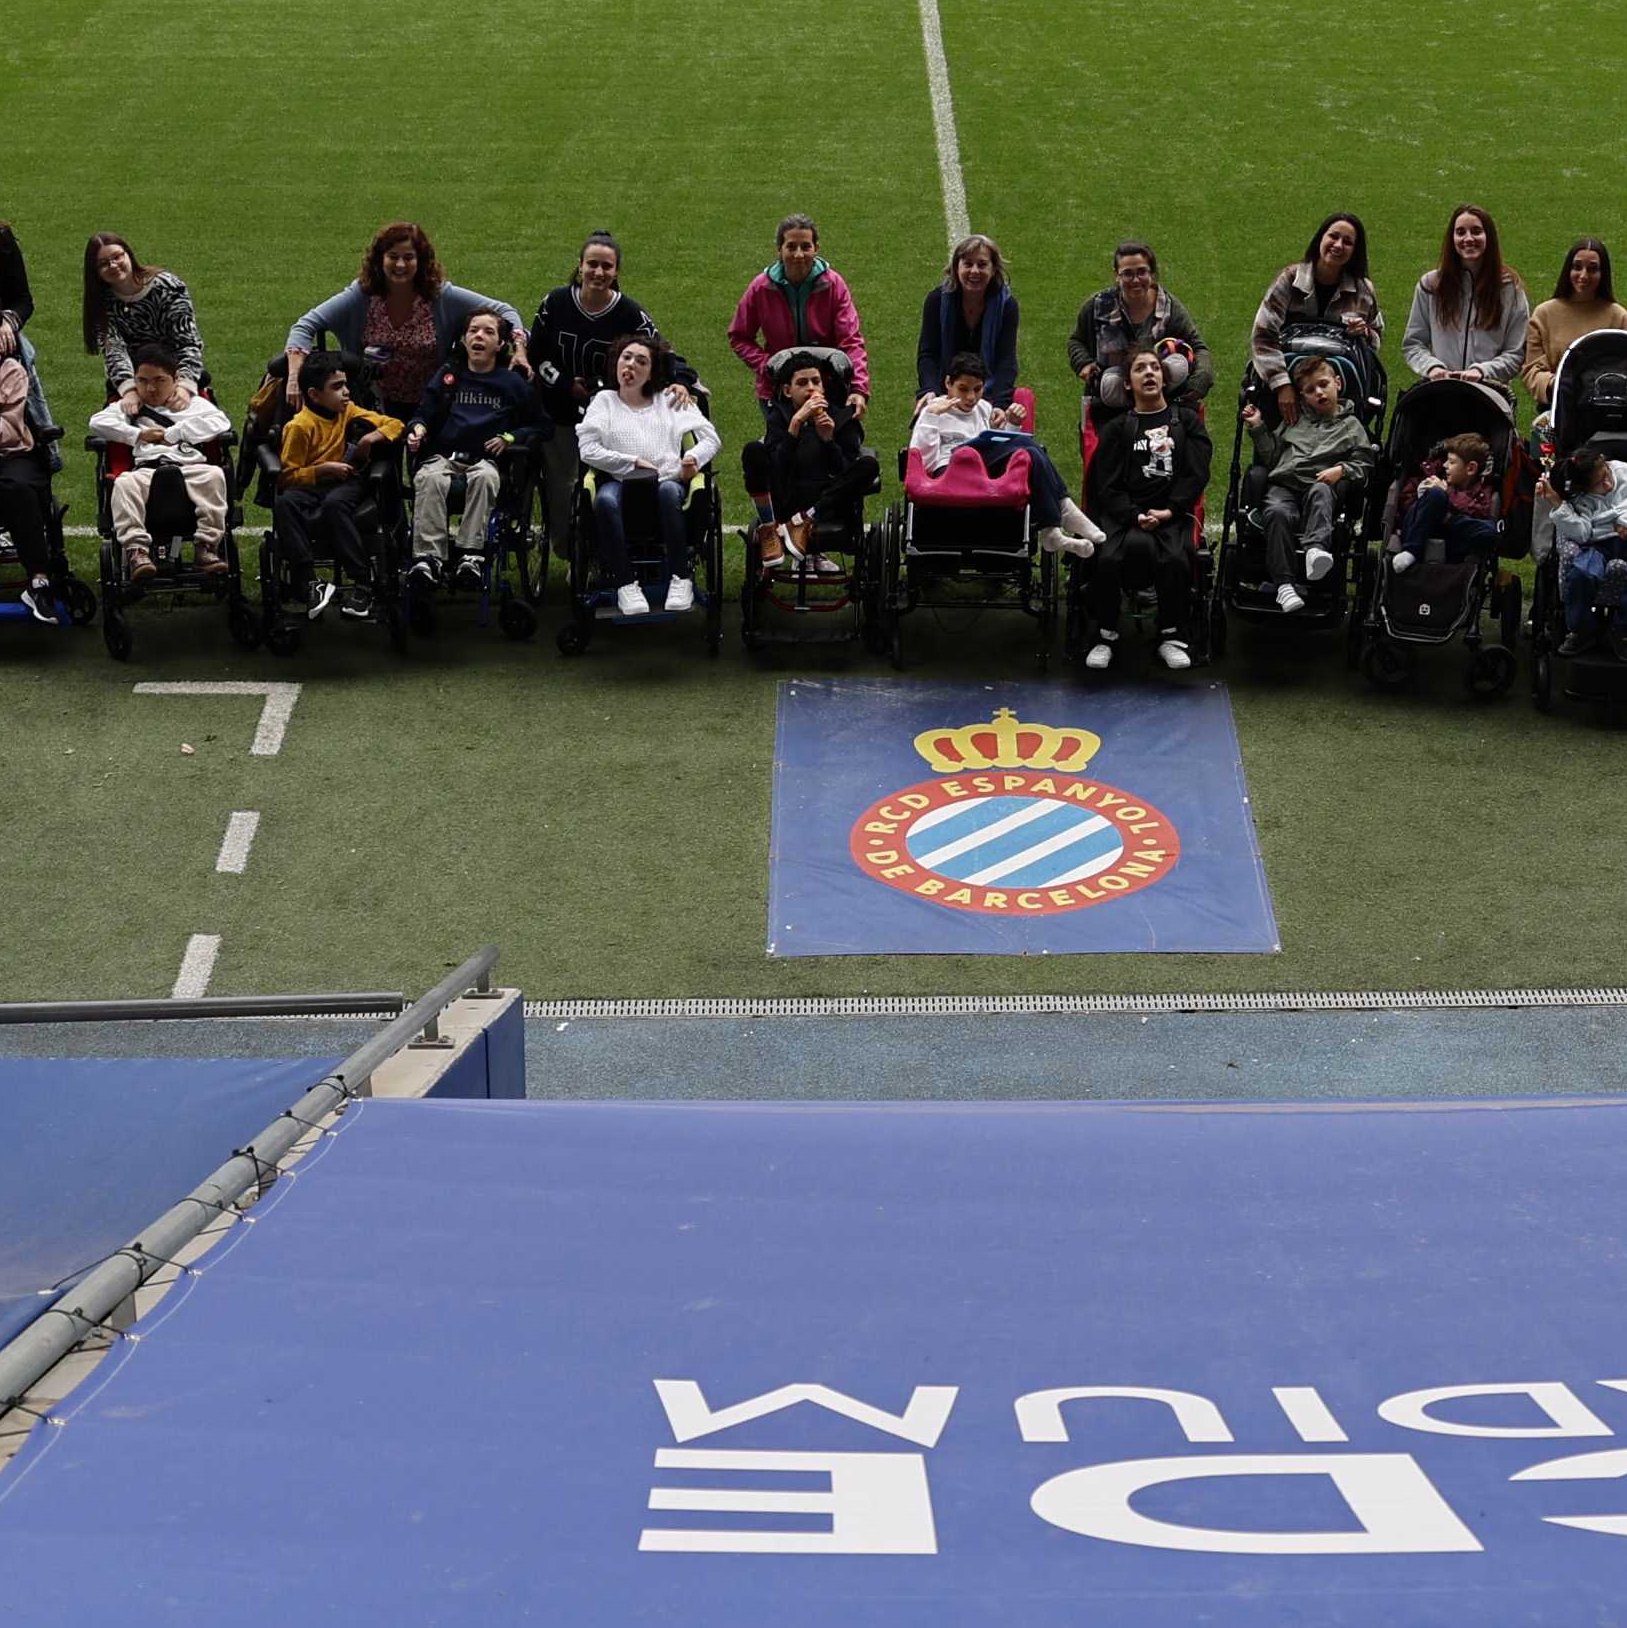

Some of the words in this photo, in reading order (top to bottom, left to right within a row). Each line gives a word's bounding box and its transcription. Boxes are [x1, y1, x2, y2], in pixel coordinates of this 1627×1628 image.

[863, 789, 931, 837] RCD
[941, 775, 1161, 836] ESPANYOL
[864, 848, 916, 881] DE
[914, 846, 1166, 910] BARCELONA
